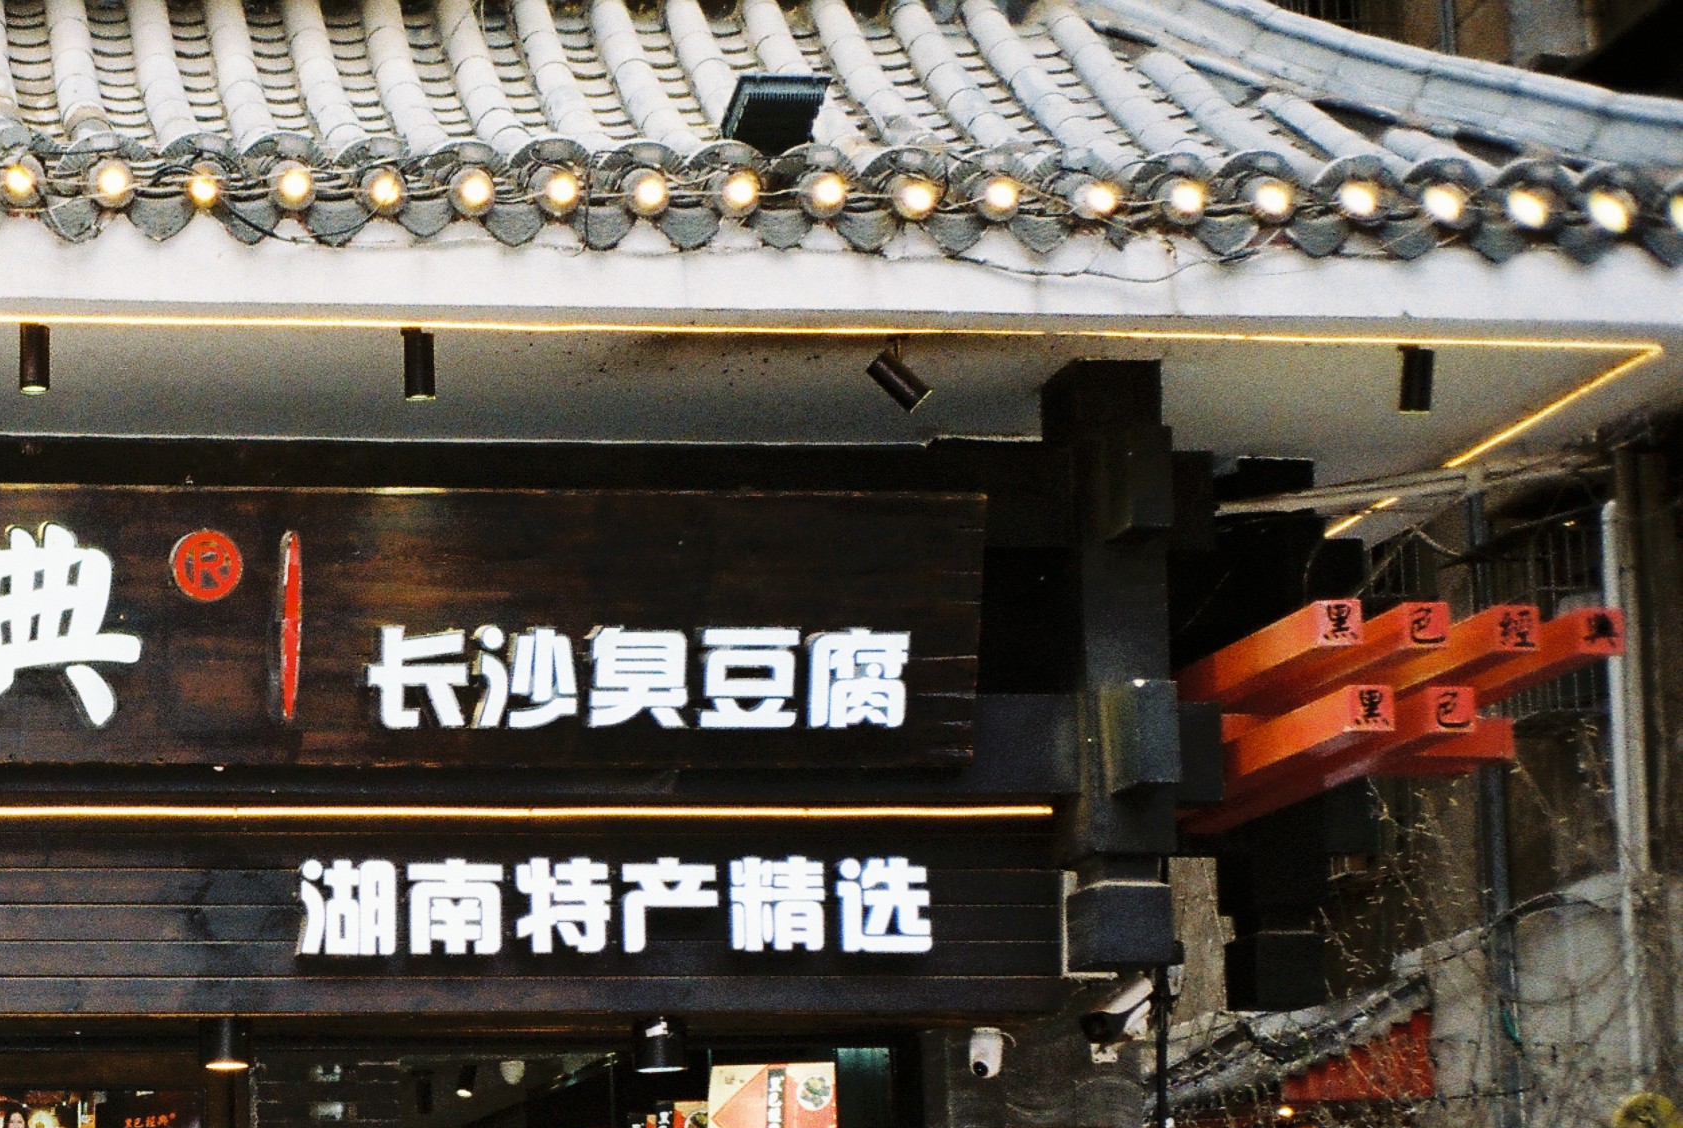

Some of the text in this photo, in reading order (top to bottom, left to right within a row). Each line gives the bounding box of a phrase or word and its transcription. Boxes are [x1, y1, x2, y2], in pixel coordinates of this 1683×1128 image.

[369, 625, 912, 730] 长沙臭豆腐
[297, 856, 933, 956] 湖南特产精选
